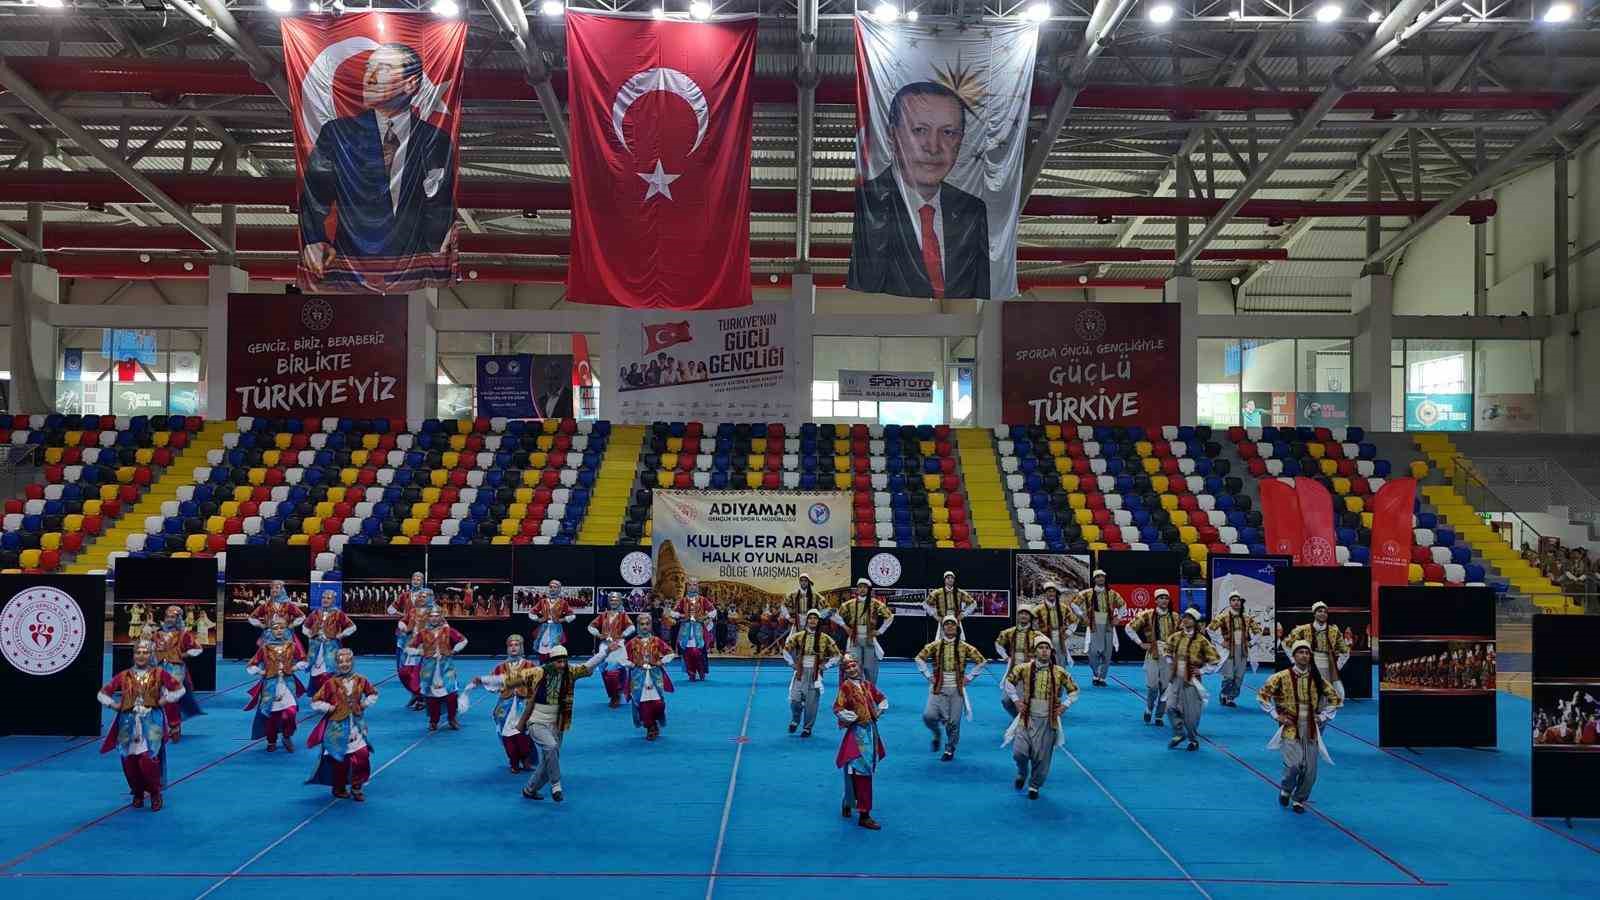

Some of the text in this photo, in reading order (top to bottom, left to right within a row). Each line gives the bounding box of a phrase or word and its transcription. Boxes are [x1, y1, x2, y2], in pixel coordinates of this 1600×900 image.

[294, 336, 324, 350] BİRİZ,
[328, 331, 385, 348] BERABERİZ
[725, 328, 769, 351] GÜCÜ
[276, 351, 352, 375] BİRLİKTE
[1016, 347, 1058, 361] SPORDA
[1050, 354, 1131, 386] GÜÇLÜ
[235, 371, 397, 413] TÜRKİYE'YİZ
[1028, 388, 1139, 425] TÜRKİYE
[709, 503, 796, 516] ADIYAMAN
[687, 534, 833, 549] KULÜPLER ARASI
[702, 552, 818, 564] HALK OYUNLARI
[719, 564, 800, 579] BÖLGE YARIŞMASI
